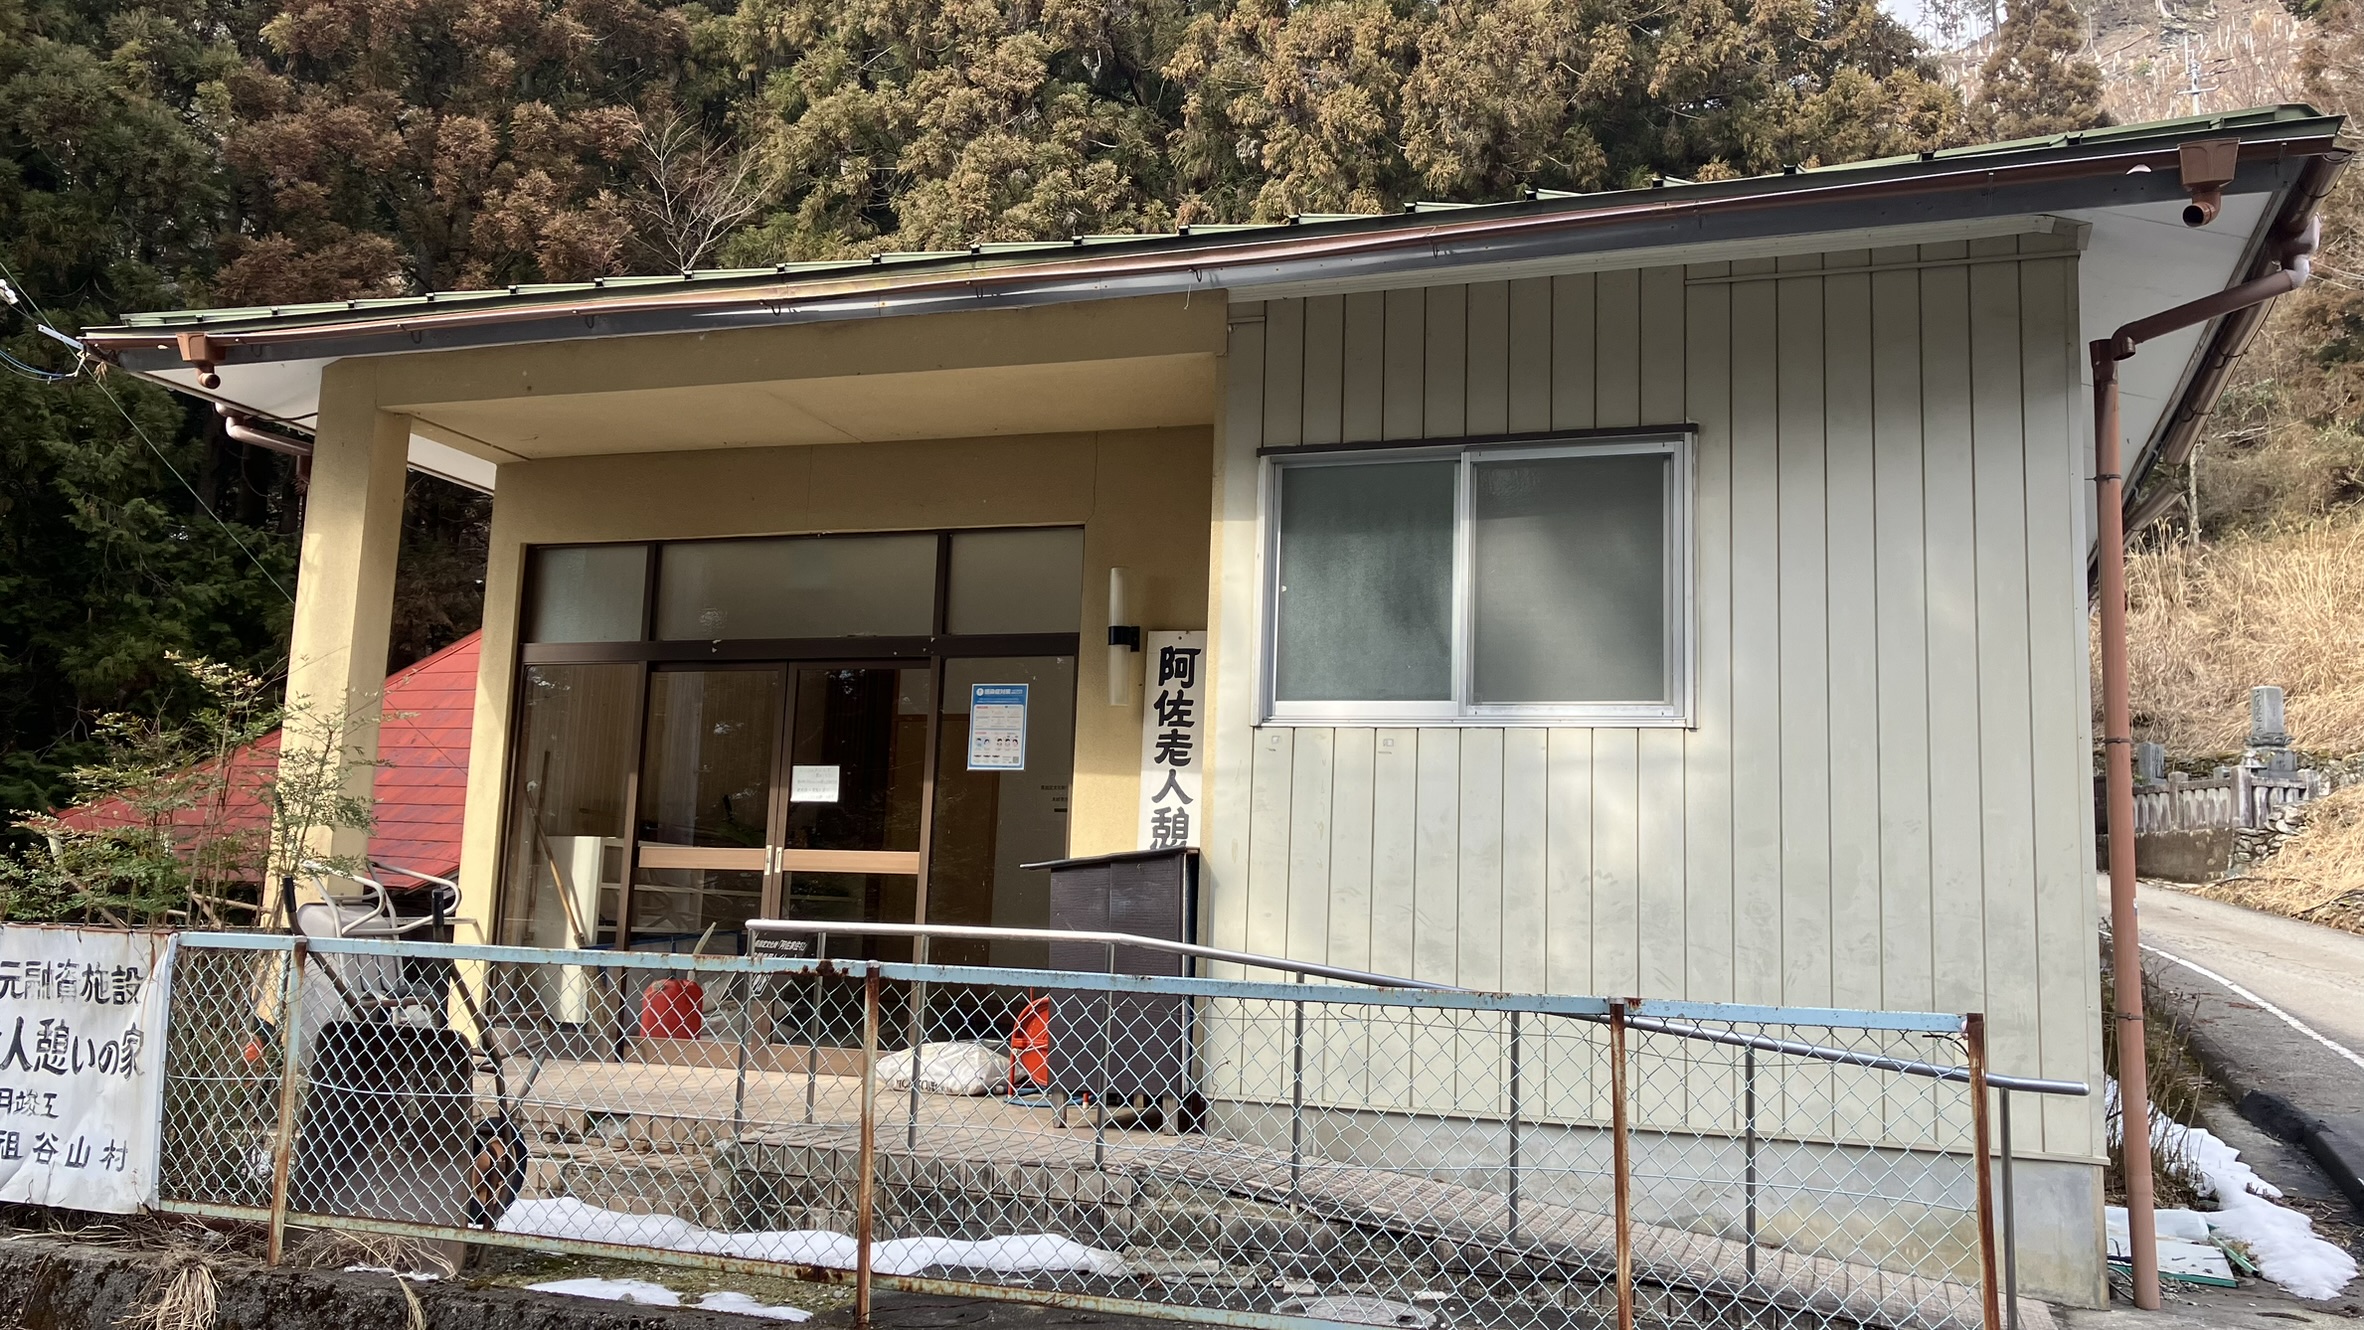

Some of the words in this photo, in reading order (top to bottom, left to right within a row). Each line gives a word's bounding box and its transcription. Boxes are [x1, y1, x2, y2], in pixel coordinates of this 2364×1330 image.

[1150, 646, 1201, 850] 阿佐老人憩
[0, 958, 144, 1005] 元融資施設
[0, 1016, 145, 1081] 人憩いの家
